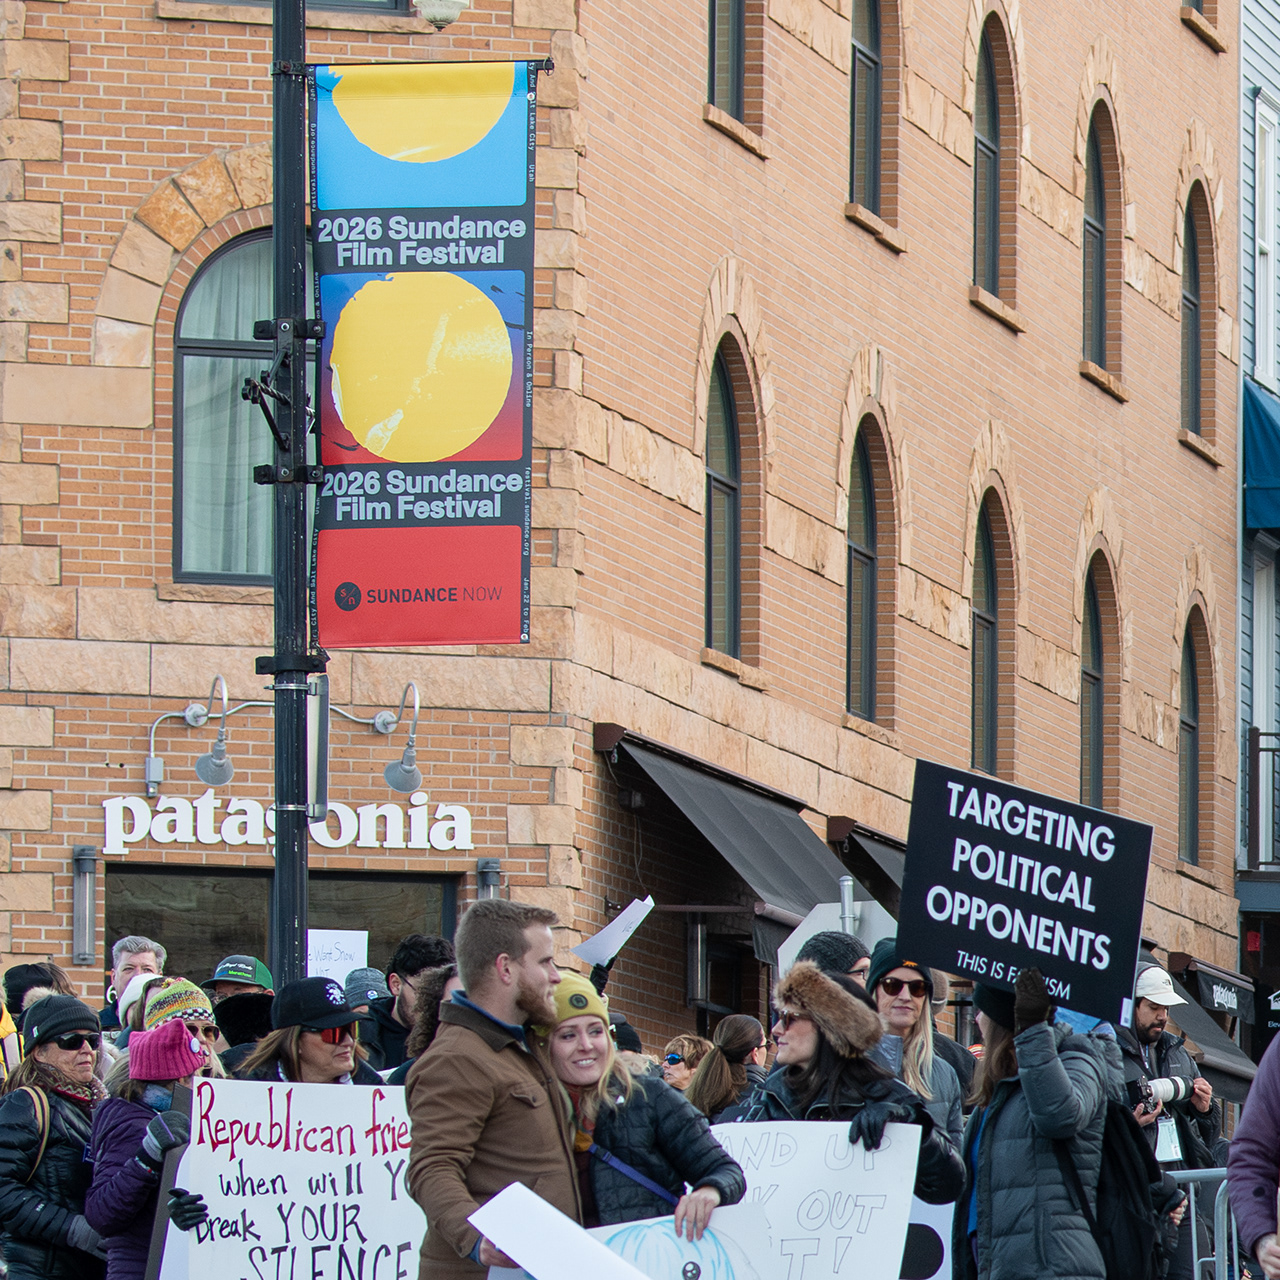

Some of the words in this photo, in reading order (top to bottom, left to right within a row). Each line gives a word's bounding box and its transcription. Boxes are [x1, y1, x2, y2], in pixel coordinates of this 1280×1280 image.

[318, 217, 382, 242] 2026
[388, 215, 527, 241] Sundance
[337, 242, 393, 267] Film
[400, 240, 505, 265] Festival
[321, 470, 381, 496] 2026
[386, 469, 523, 494] Sundance
[336, 497, 391, 521] Film
[397, 494, 501, 519] Festival
[366, 587, 458, 604] SUNDANCE
[462, 586, 503, 602] NOW
[947, 781, 1116, 862] TARGETING
[952, 838, 1096, 913] POLITICAL
[926, 885, 1111, 971] OPPONENTS
[957, 950, 988, 972] THIS
[990, 962, 1004, 979] IS
[196, 1080, 357, 1162] Republican
[364, 1088, 412, 1157] frie
[824, 1133, 892, 1172] UP
[219, 1158, 288, 1198] when
[308, 1162, 364, 1197] will
[277, 1201, 368, 1244] YOUR
[796, 1189, 887, 1234] OUT
